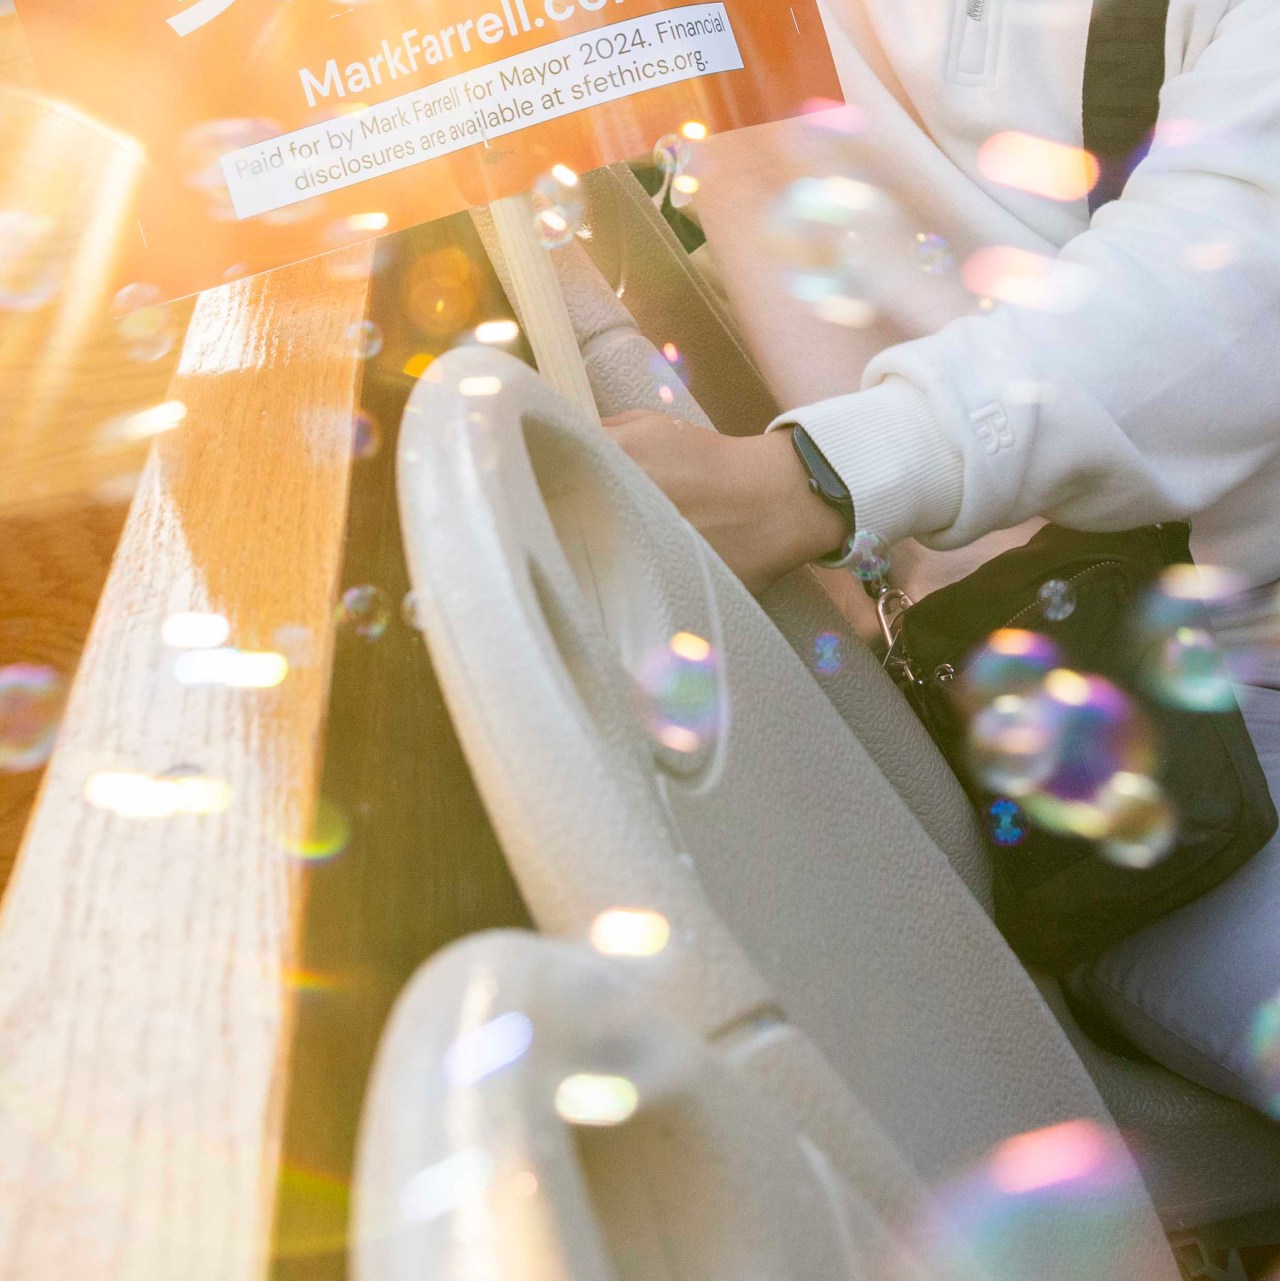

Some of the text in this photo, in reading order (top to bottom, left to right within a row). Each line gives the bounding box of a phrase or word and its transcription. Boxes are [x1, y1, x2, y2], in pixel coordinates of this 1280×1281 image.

[235, 12, 726, 180] Paid for by Mark Farrell for Mayor 2024. Financial
[294, 48, 709, 192] disclosures are available at sfethics.org.
